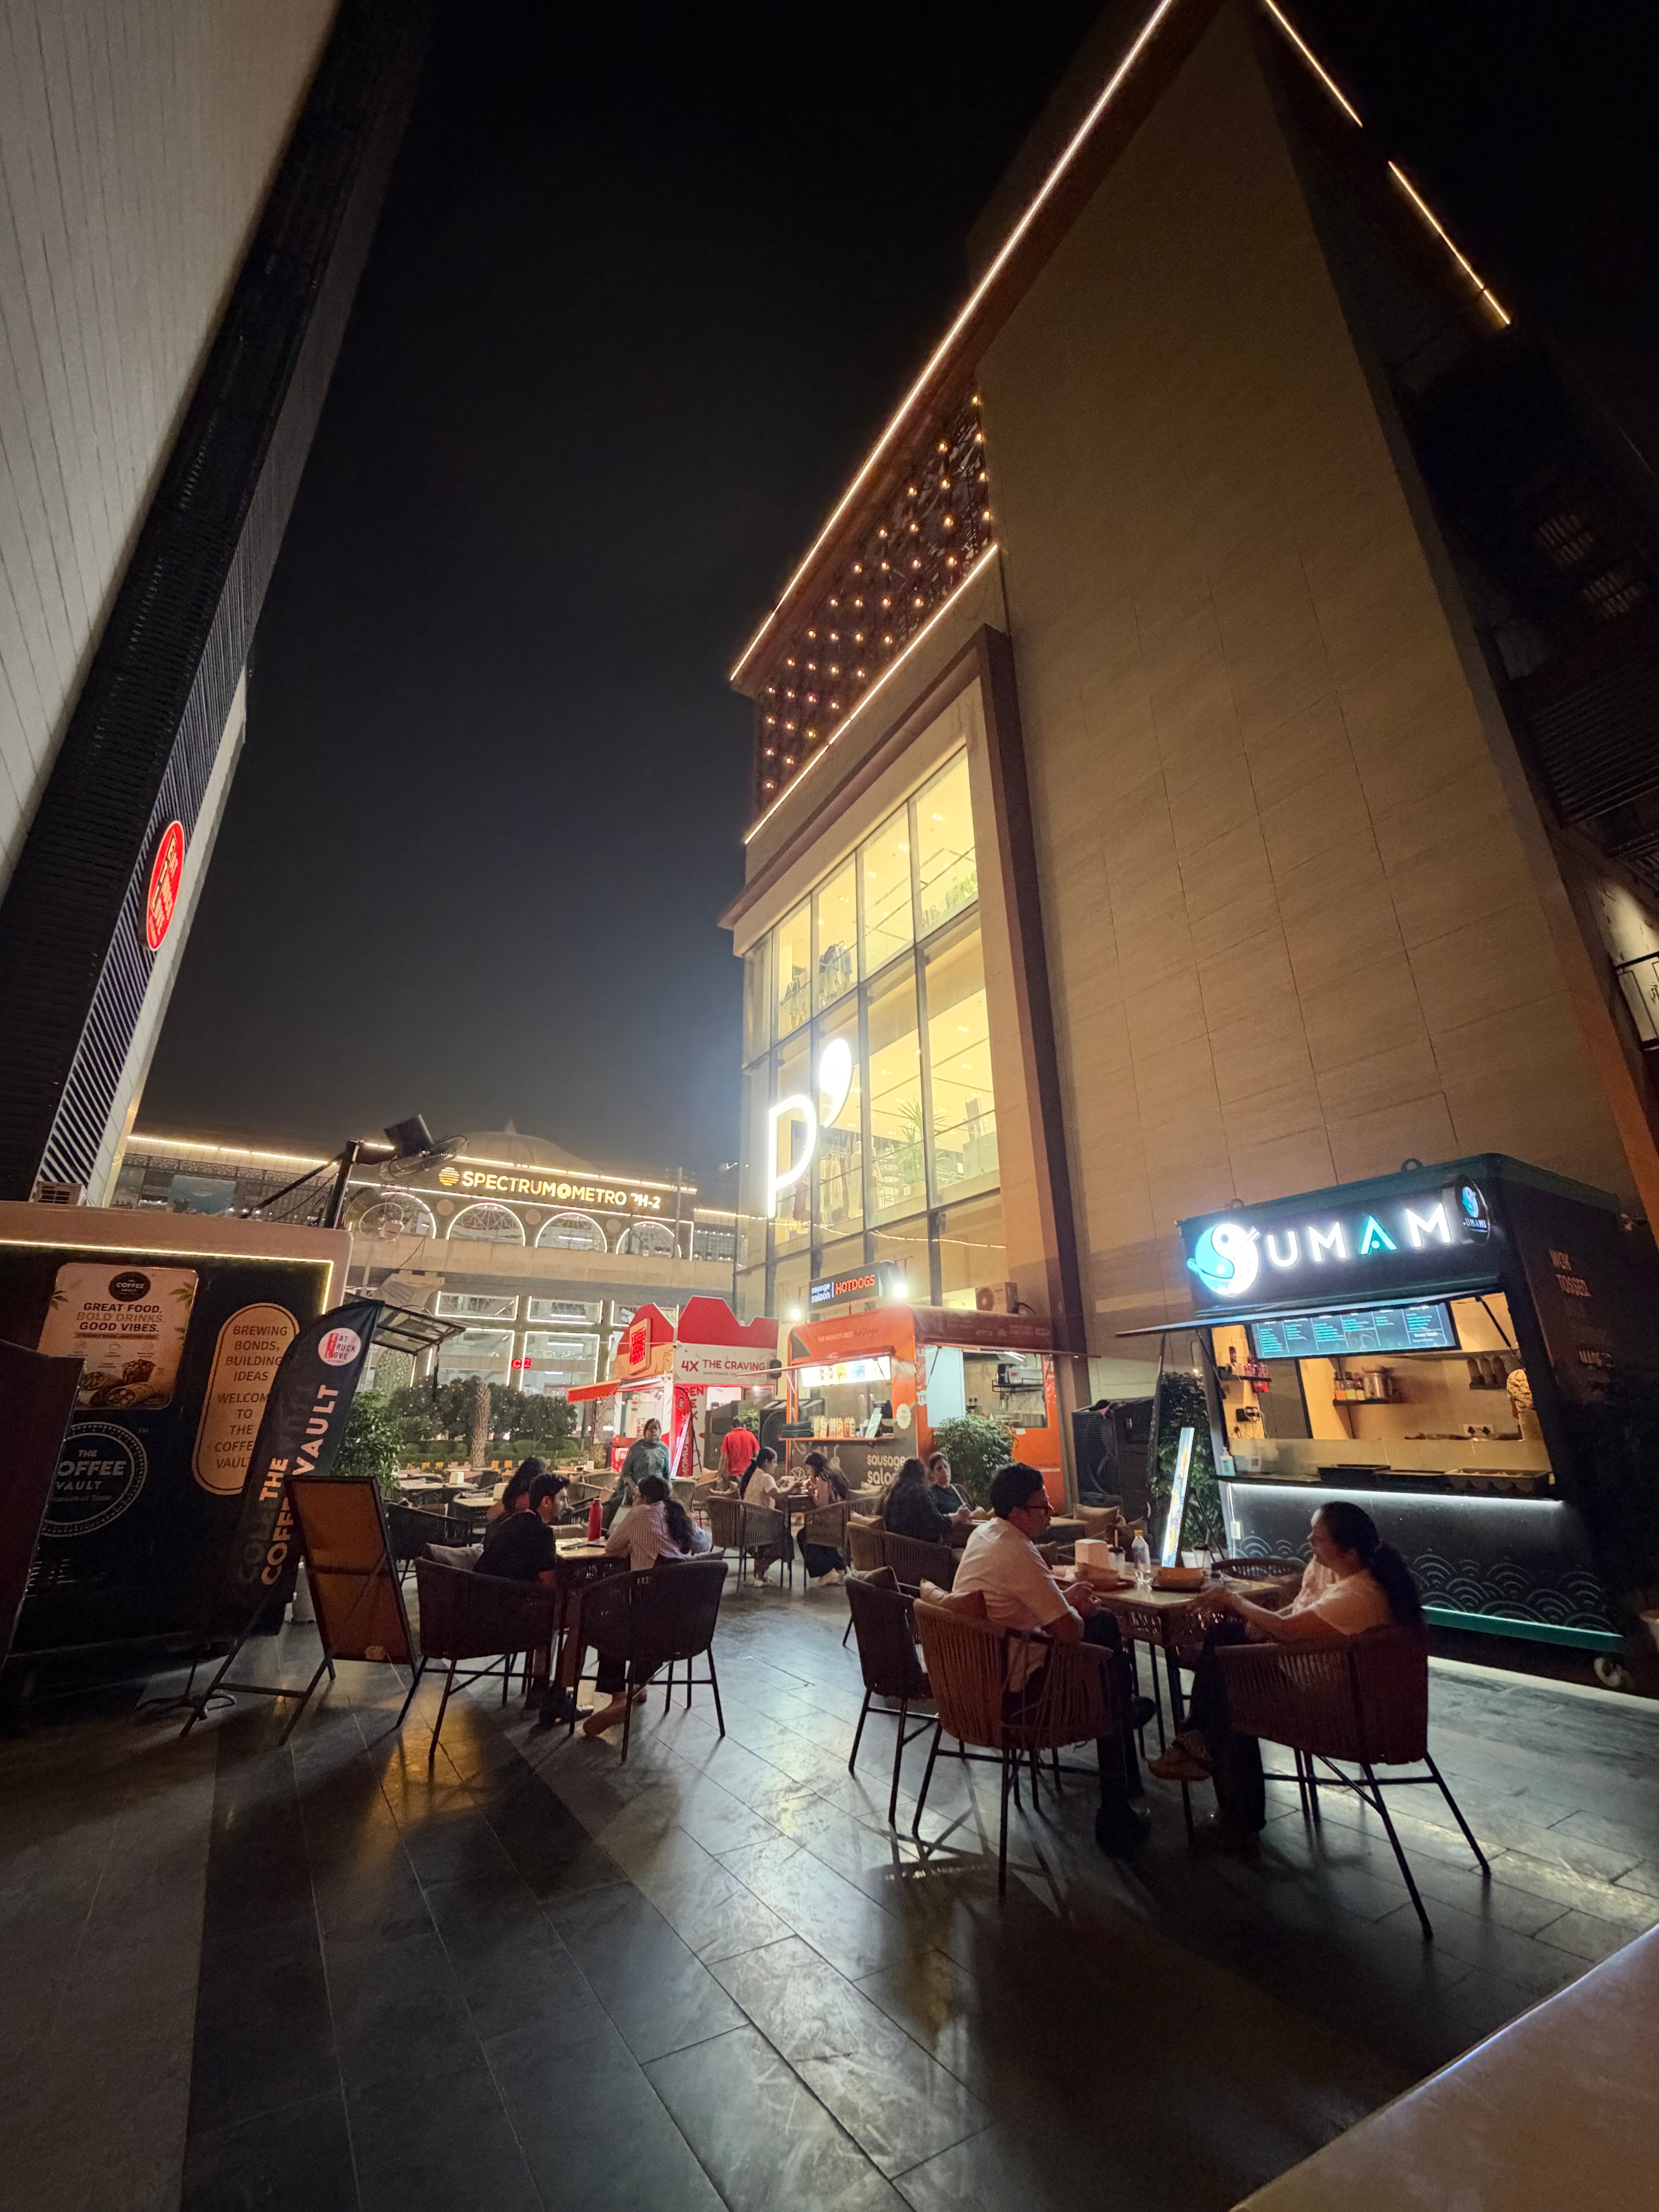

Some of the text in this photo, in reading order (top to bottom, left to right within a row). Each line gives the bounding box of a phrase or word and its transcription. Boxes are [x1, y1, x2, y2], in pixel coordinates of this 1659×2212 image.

[1465, 1217, 1487, 1228] UMAMI
[835, 1274, 876, 1294] HOTDOGS
[811, 1292, 831, 1303] saloon
[83, 1302, 162, 1314] GREAT FOOD.
[77, 1312, 166, 1323] BOLD DRINKS.
[79, 1322, 159, 1332] GOOD VIBES.
[233, 1326, 288, 1336] BREWING
[234, 1341, 280, 1351] BONDS,
[225, 1356, 283, 1366] BUILDING
[681, 1359, 765, 1372] 4X THE CRAVING
[233, 1371, 269, 1381] IDEAS
[218, 1393, 268, 1404] WELCOM
[237, 1408, 253, 1419] TO
[229, 1425, 254, 1435] THE
[292, 1384, 339, 1476] VAULT
[214, 1441, 254, 1453] COFFE
[78, 1449, 98, 1458] THE
[57, 1460, 127, 1476] OFFEE
[216, 1457, 251, 1468] VAUL
[867, 1454, 905, 1471] sausage
[259, 1458, 289, 1501] THE
[867, 1467, 898, 1486] salo
[56, 1480, 103, 1492] VAULT
[261, 1497, 294, 1585] COFF
